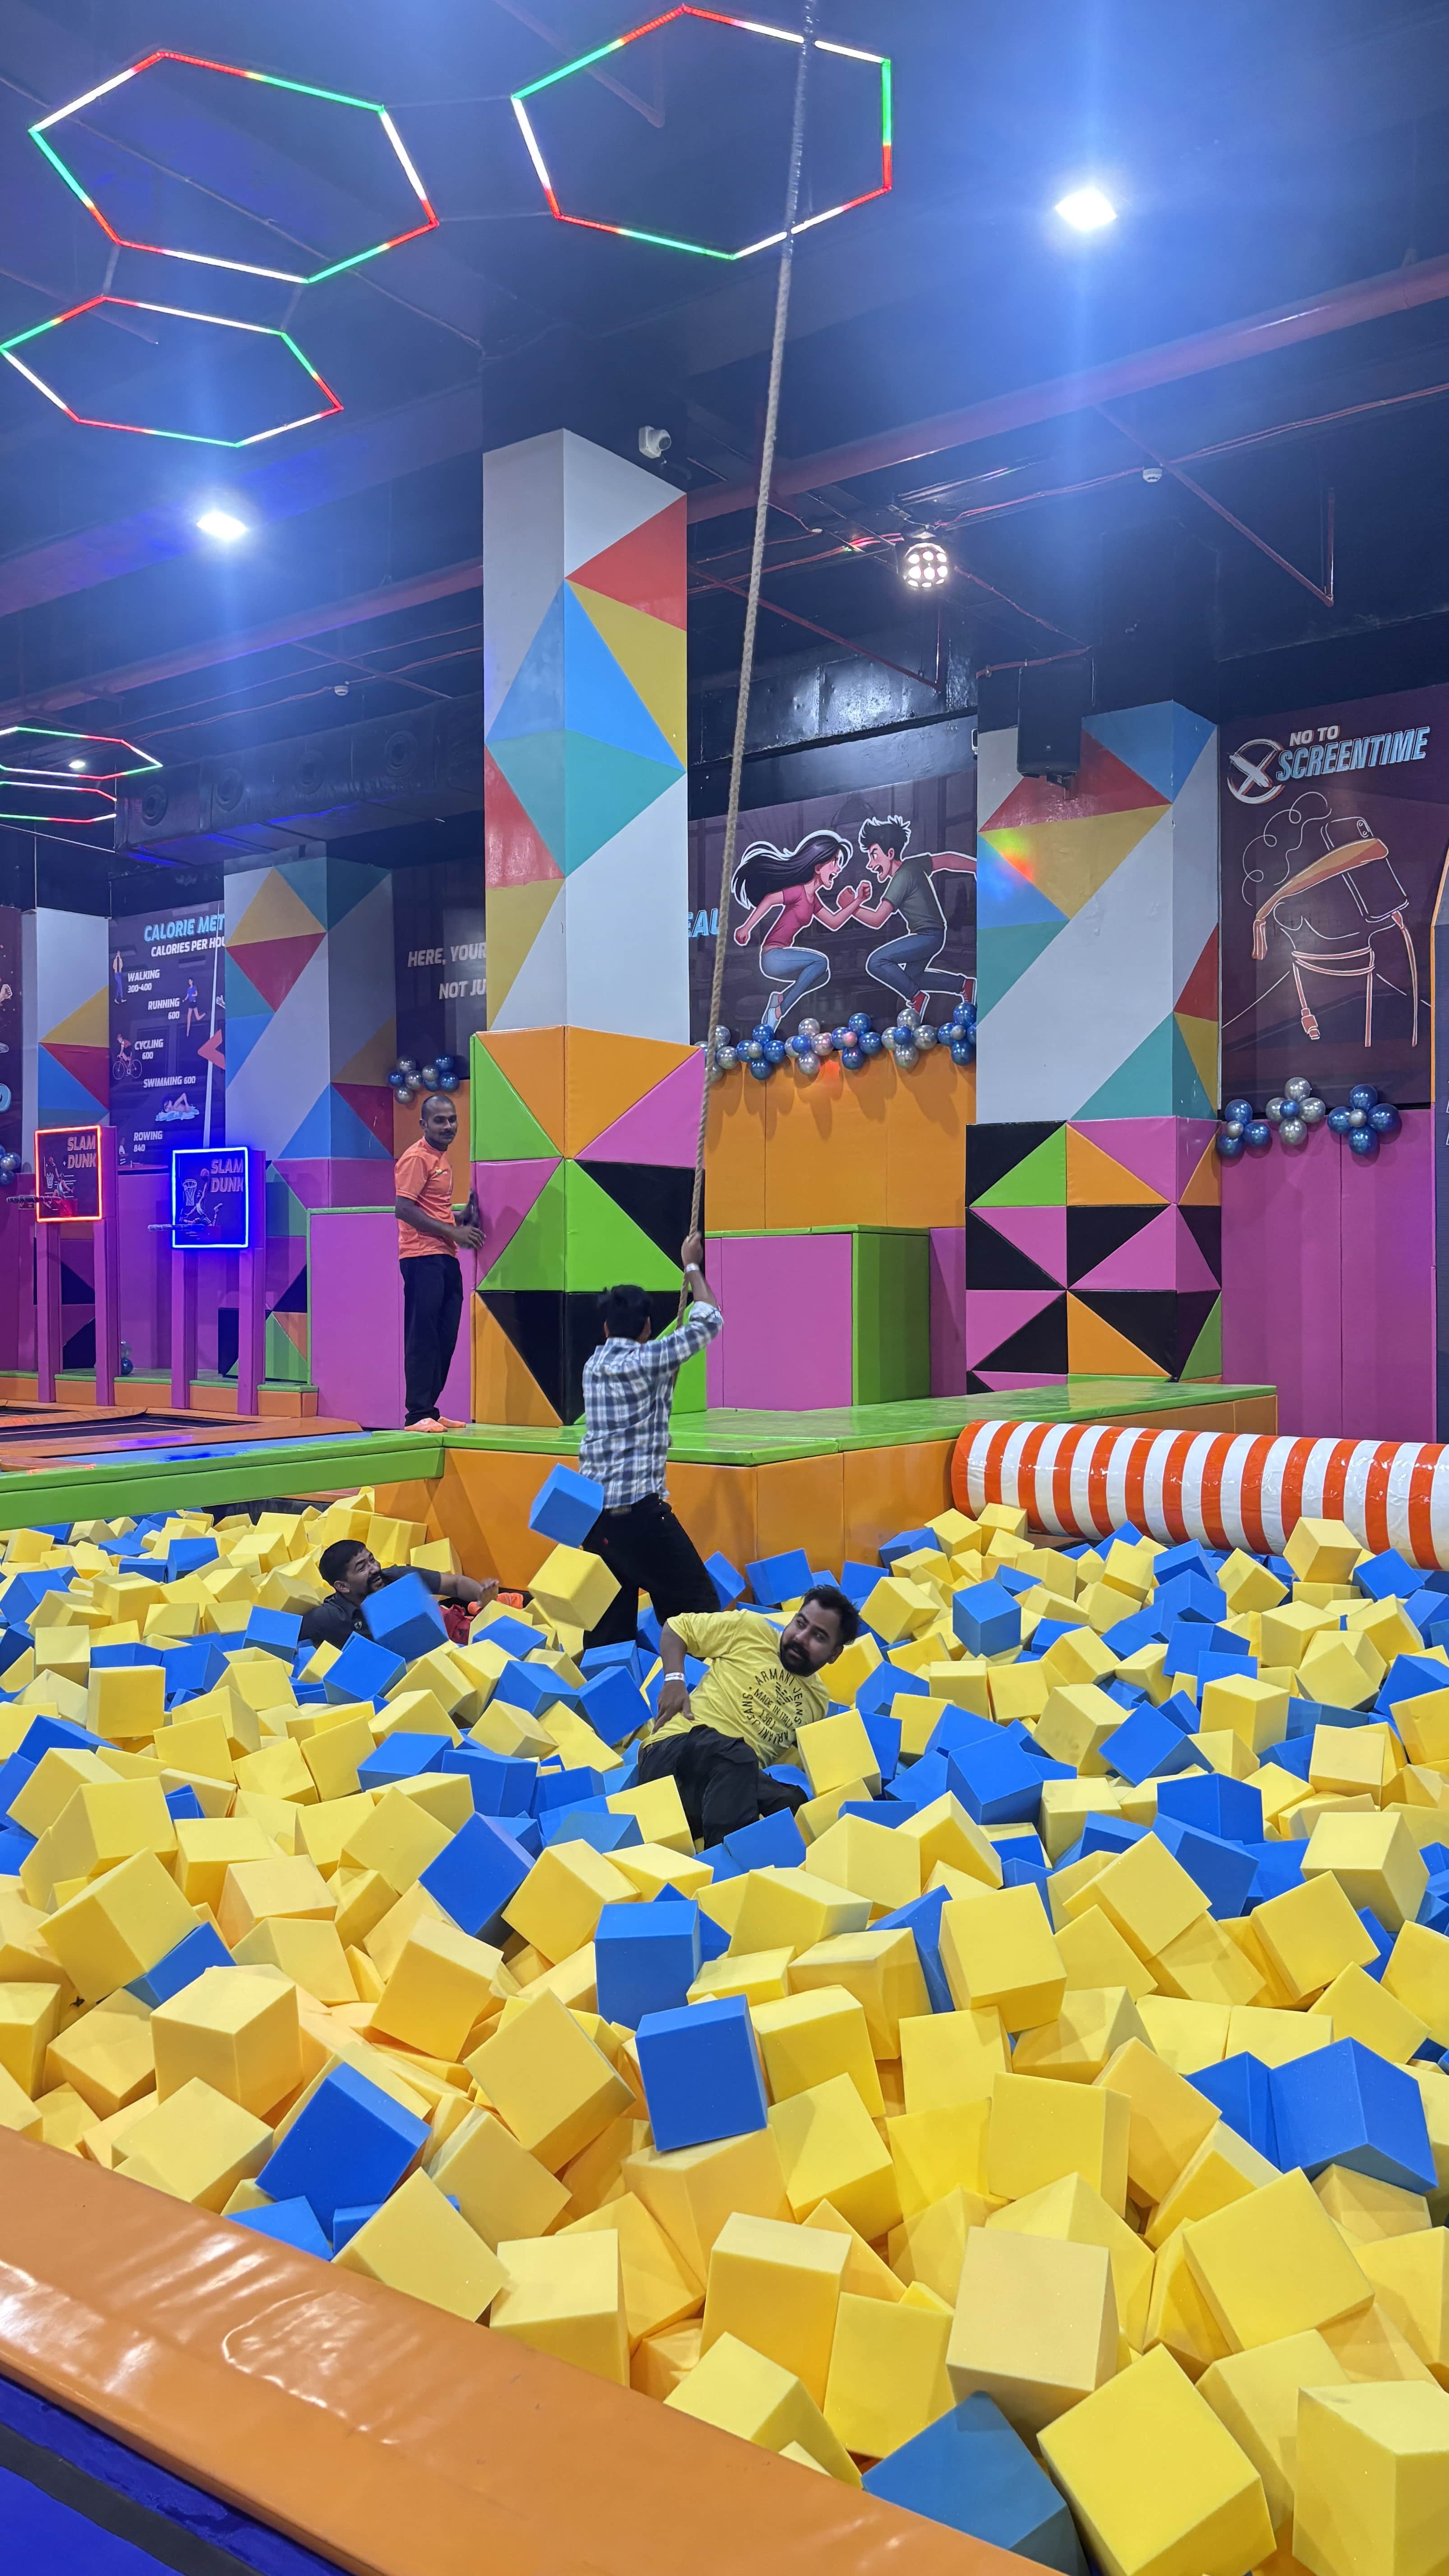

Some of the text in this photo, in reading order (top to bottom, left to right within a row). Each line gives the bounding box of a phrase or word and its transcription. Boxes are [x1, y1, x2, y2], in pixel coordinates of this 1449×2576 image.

[1289, 725, 1340, 747] NO TO
[1275, 726, 1431, 782] SCREENTIME
[144, 913, 225, 942] CALORIE MET
[151, 941, 190, 957] CALORIES
[191, 938, 207, 952] PER
[408, 942, 486, 967] HERE, YOUR
[128, 969, 160, 982] WALKING
[127, 983, 152, 993] 300-400
[439, 980, 468, 1000] NOT
[147, 998, 180, 1010] RUNNING
[168, 1011, 180, 1020] 600
[134, 1039, 164, 1050] CYCLING
[142, 1052, 154, 1060] 600
[143, 1076, 196, 1088] SWIMMING 600
[67, 1135, 96, 1151] SLAM
[133, 1131, 163, 1141] ROWING
[133, 1144, 146, 1152] 840
[67, 1153, 97, 1169] DUNK
[211, 1158, 244, 1174] SLAM
[210, 1176, 244, 1193] DUNK
[754, 1668, 803, 1725] ARMANI JEANS
[754, 1688, 774, 1709] MADE
[773, 1705, 781, 1716] IN
[742, 1693, 761, 1725] JEANS
